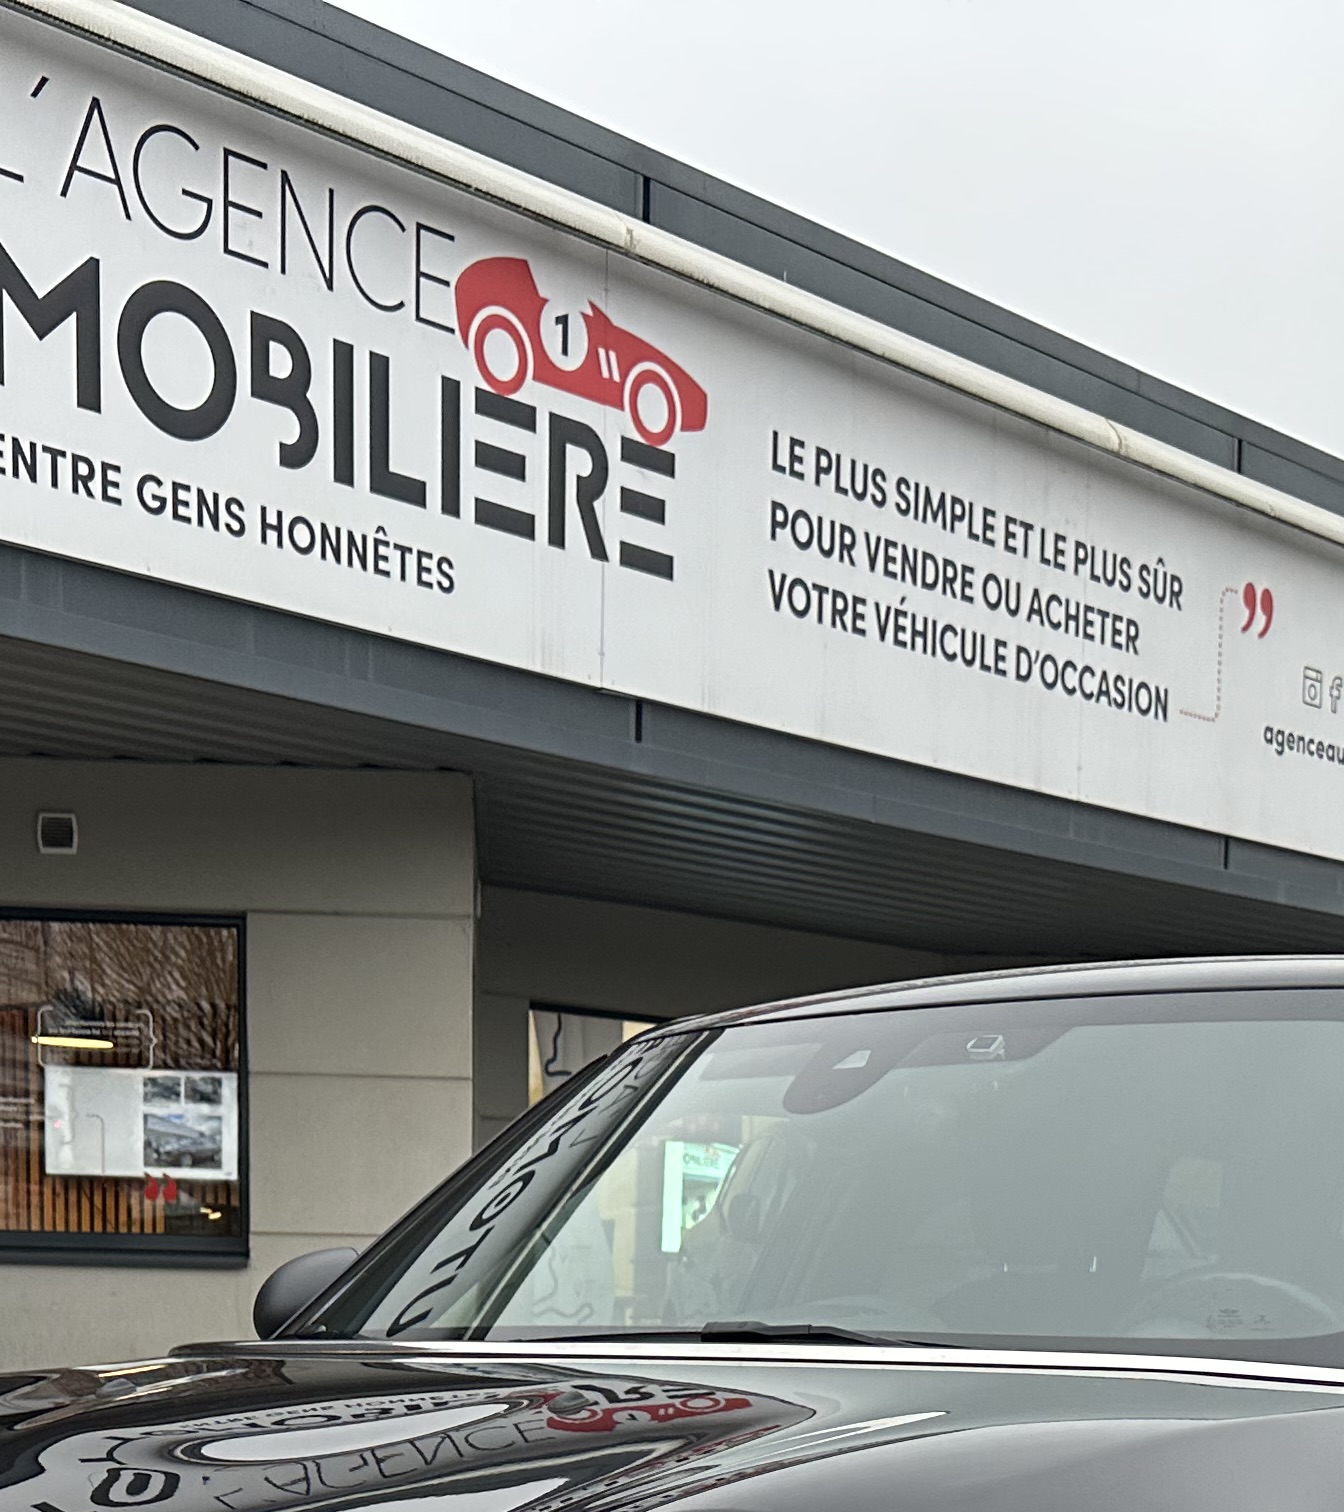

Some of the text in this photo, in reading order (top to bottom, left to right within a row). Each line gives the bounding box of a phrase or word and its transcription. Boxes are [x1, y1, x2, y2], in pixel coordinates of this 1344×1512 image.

[136, 475, 246, 538] GENS
[258, 512, 456, 595] HONNÊTES
[770, 499, 1140, 656] POUR VENDRE OU ACHETER
[771, 430, 1184, 612] LE PLUS SIMPLE ET LE PLUS SÛR
[767, 568, 1169, 723] VOTRE VÉHICULE D'OCCASION
